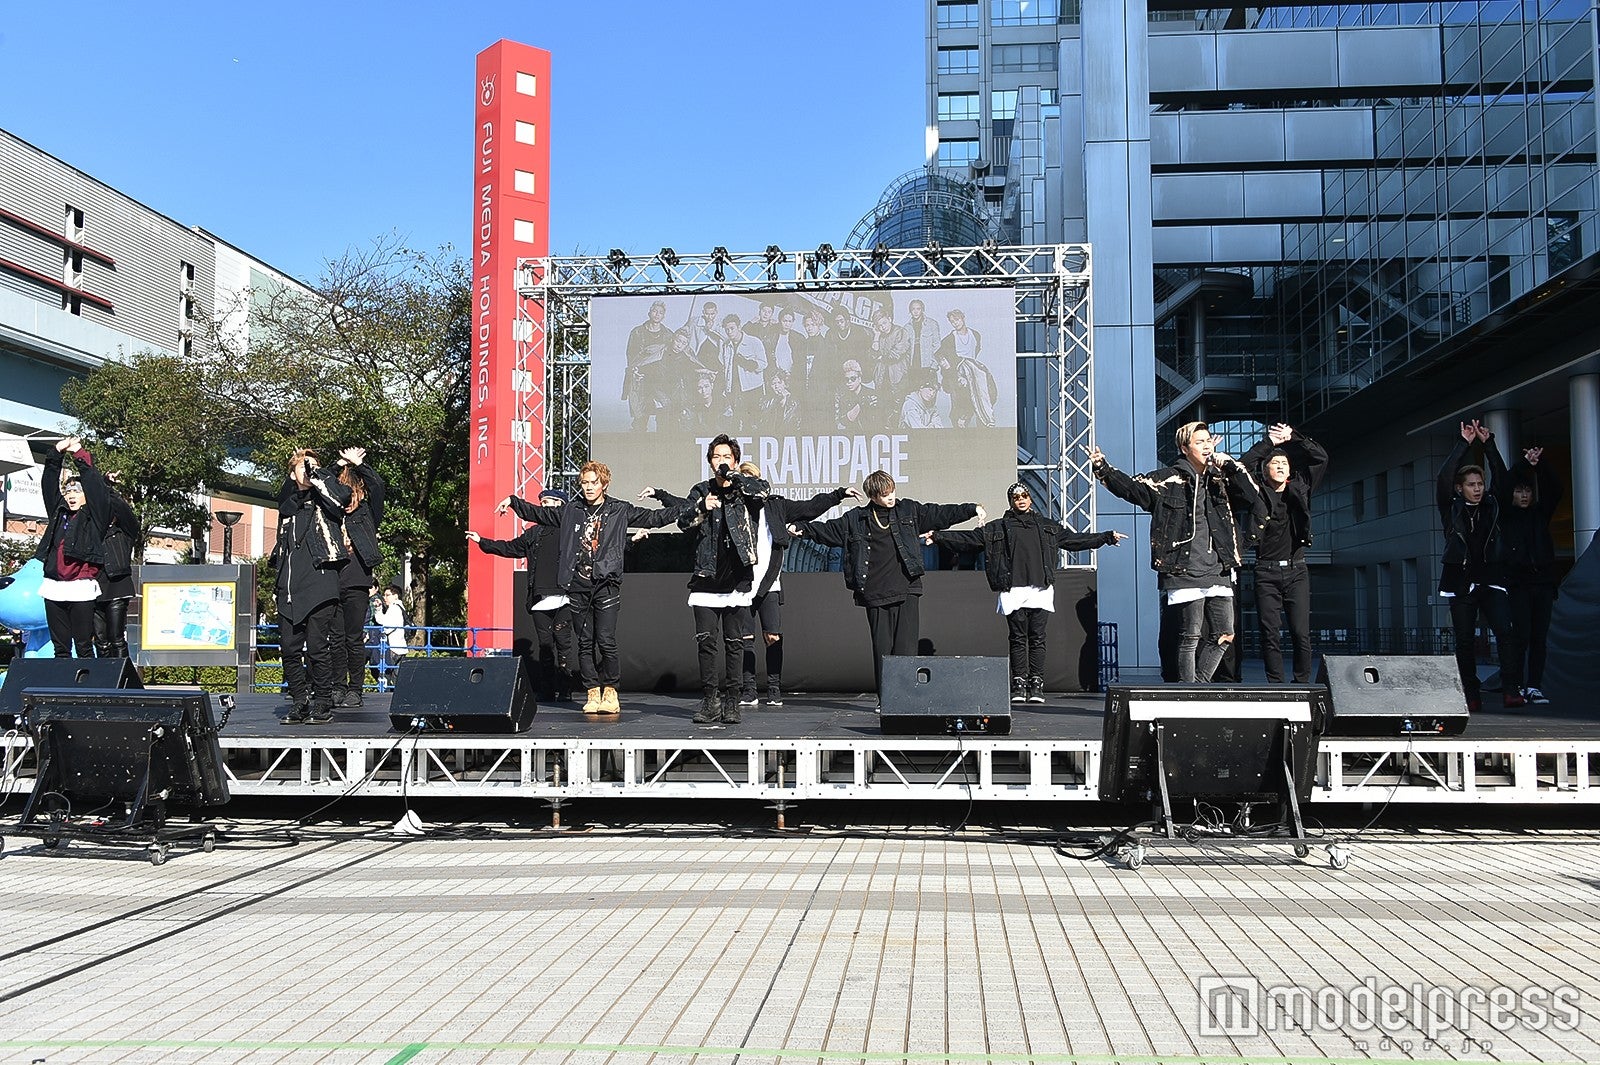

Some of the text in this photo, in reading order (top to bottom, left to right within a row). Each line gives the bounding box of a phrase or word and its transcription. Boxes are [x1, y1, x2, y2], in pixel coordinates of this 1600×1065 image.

[477, 121, 493, 465] FUJI MEDIA HOLDINGS, INC.
[695, 434, 909, 485] TE RAMPAGE
[790, 487, 813, 500] EXILE
